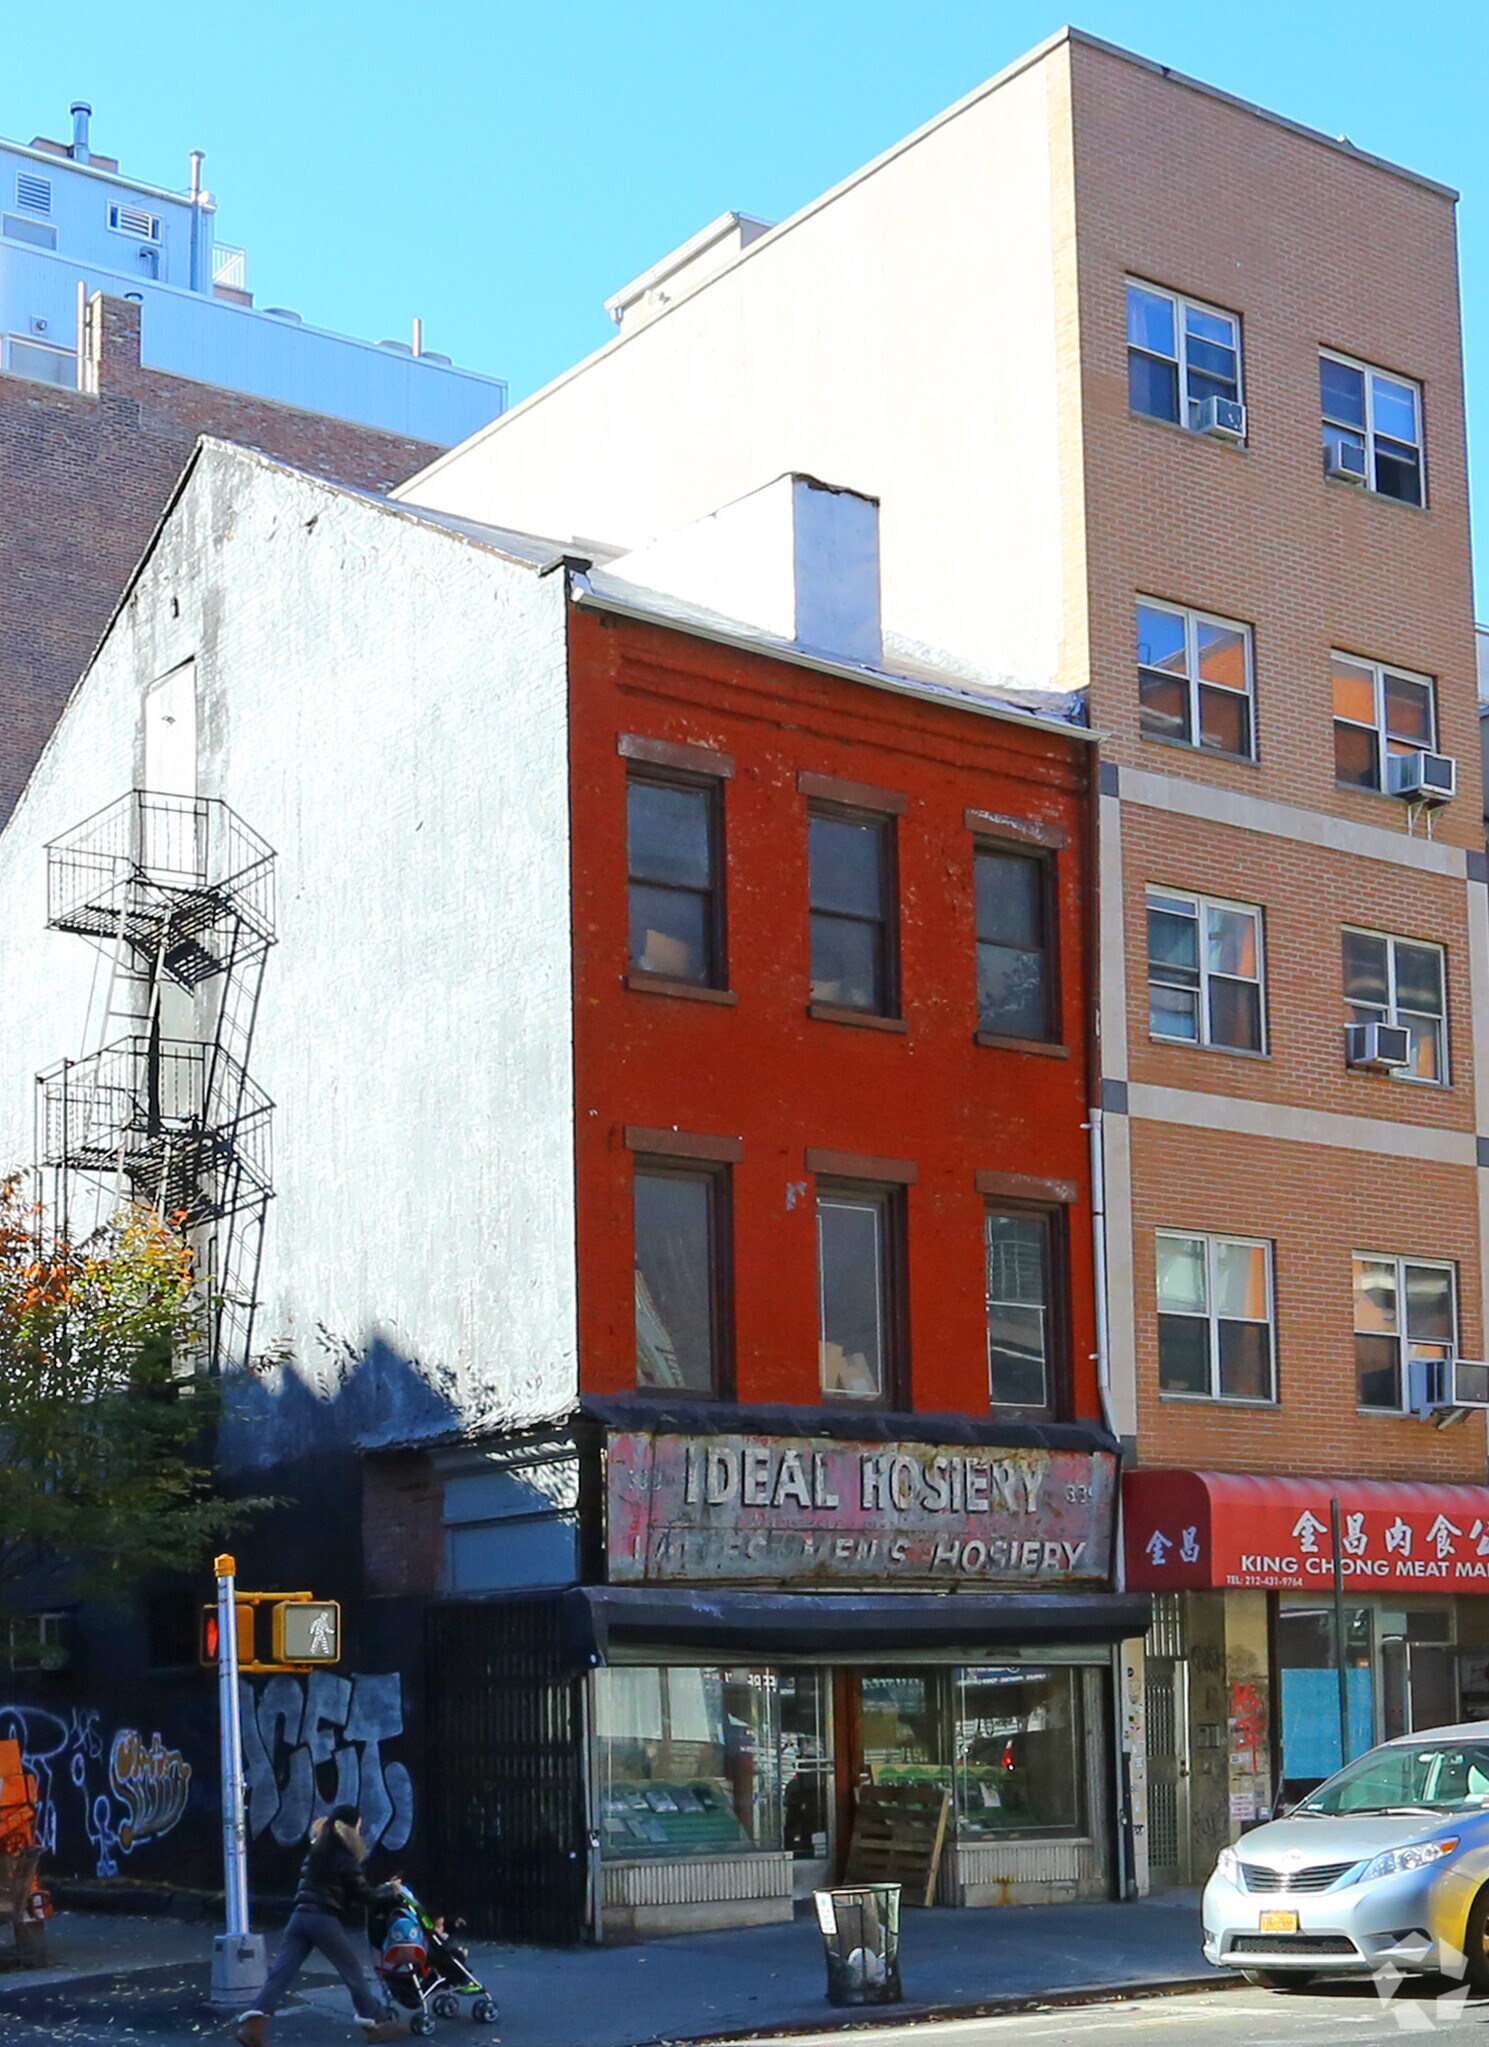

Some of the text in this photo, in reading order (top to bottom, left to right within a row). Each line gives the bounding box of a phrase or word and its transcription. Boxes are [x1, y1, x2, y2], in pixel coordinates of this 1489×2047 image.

[685, 1447, 1044, 1514] IDEAL HOSIERY
[930, 1541, 1087, 1573] HOSIERY
[1241, 1555, 1489, 1577] KING CHONG MEAT MA
[1226, 1575, 1242, 1585] TEL:
